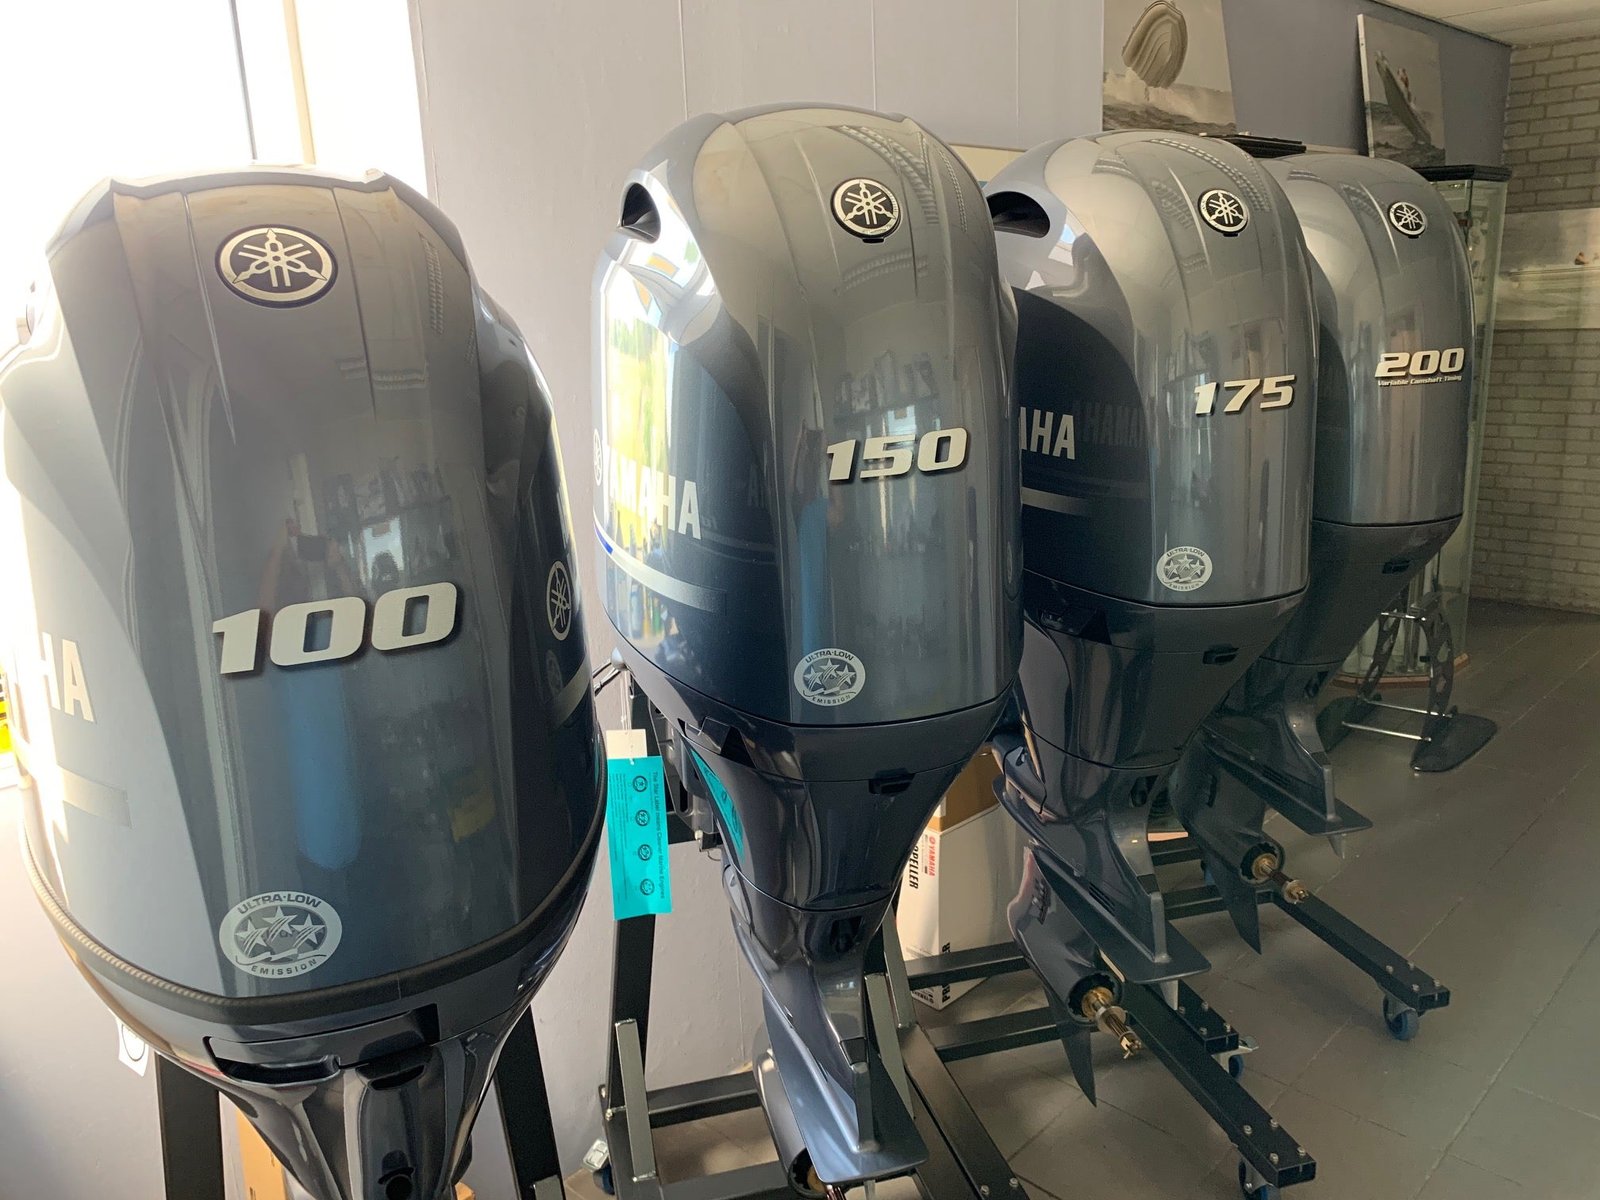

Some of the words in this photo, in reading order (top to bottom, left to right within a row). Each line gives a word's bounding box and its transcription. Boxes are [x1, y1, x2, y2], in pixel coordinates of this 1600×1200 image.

[1375, 348, 1465, 377] 200
[1194, 375, 1295, 414] 175
[827, 427, 967, 481] 150
[212, 581, 457, 674] 100
[812, 694, 851, 705] EMISSION
[251, 958, 317, 975] EMISSION
